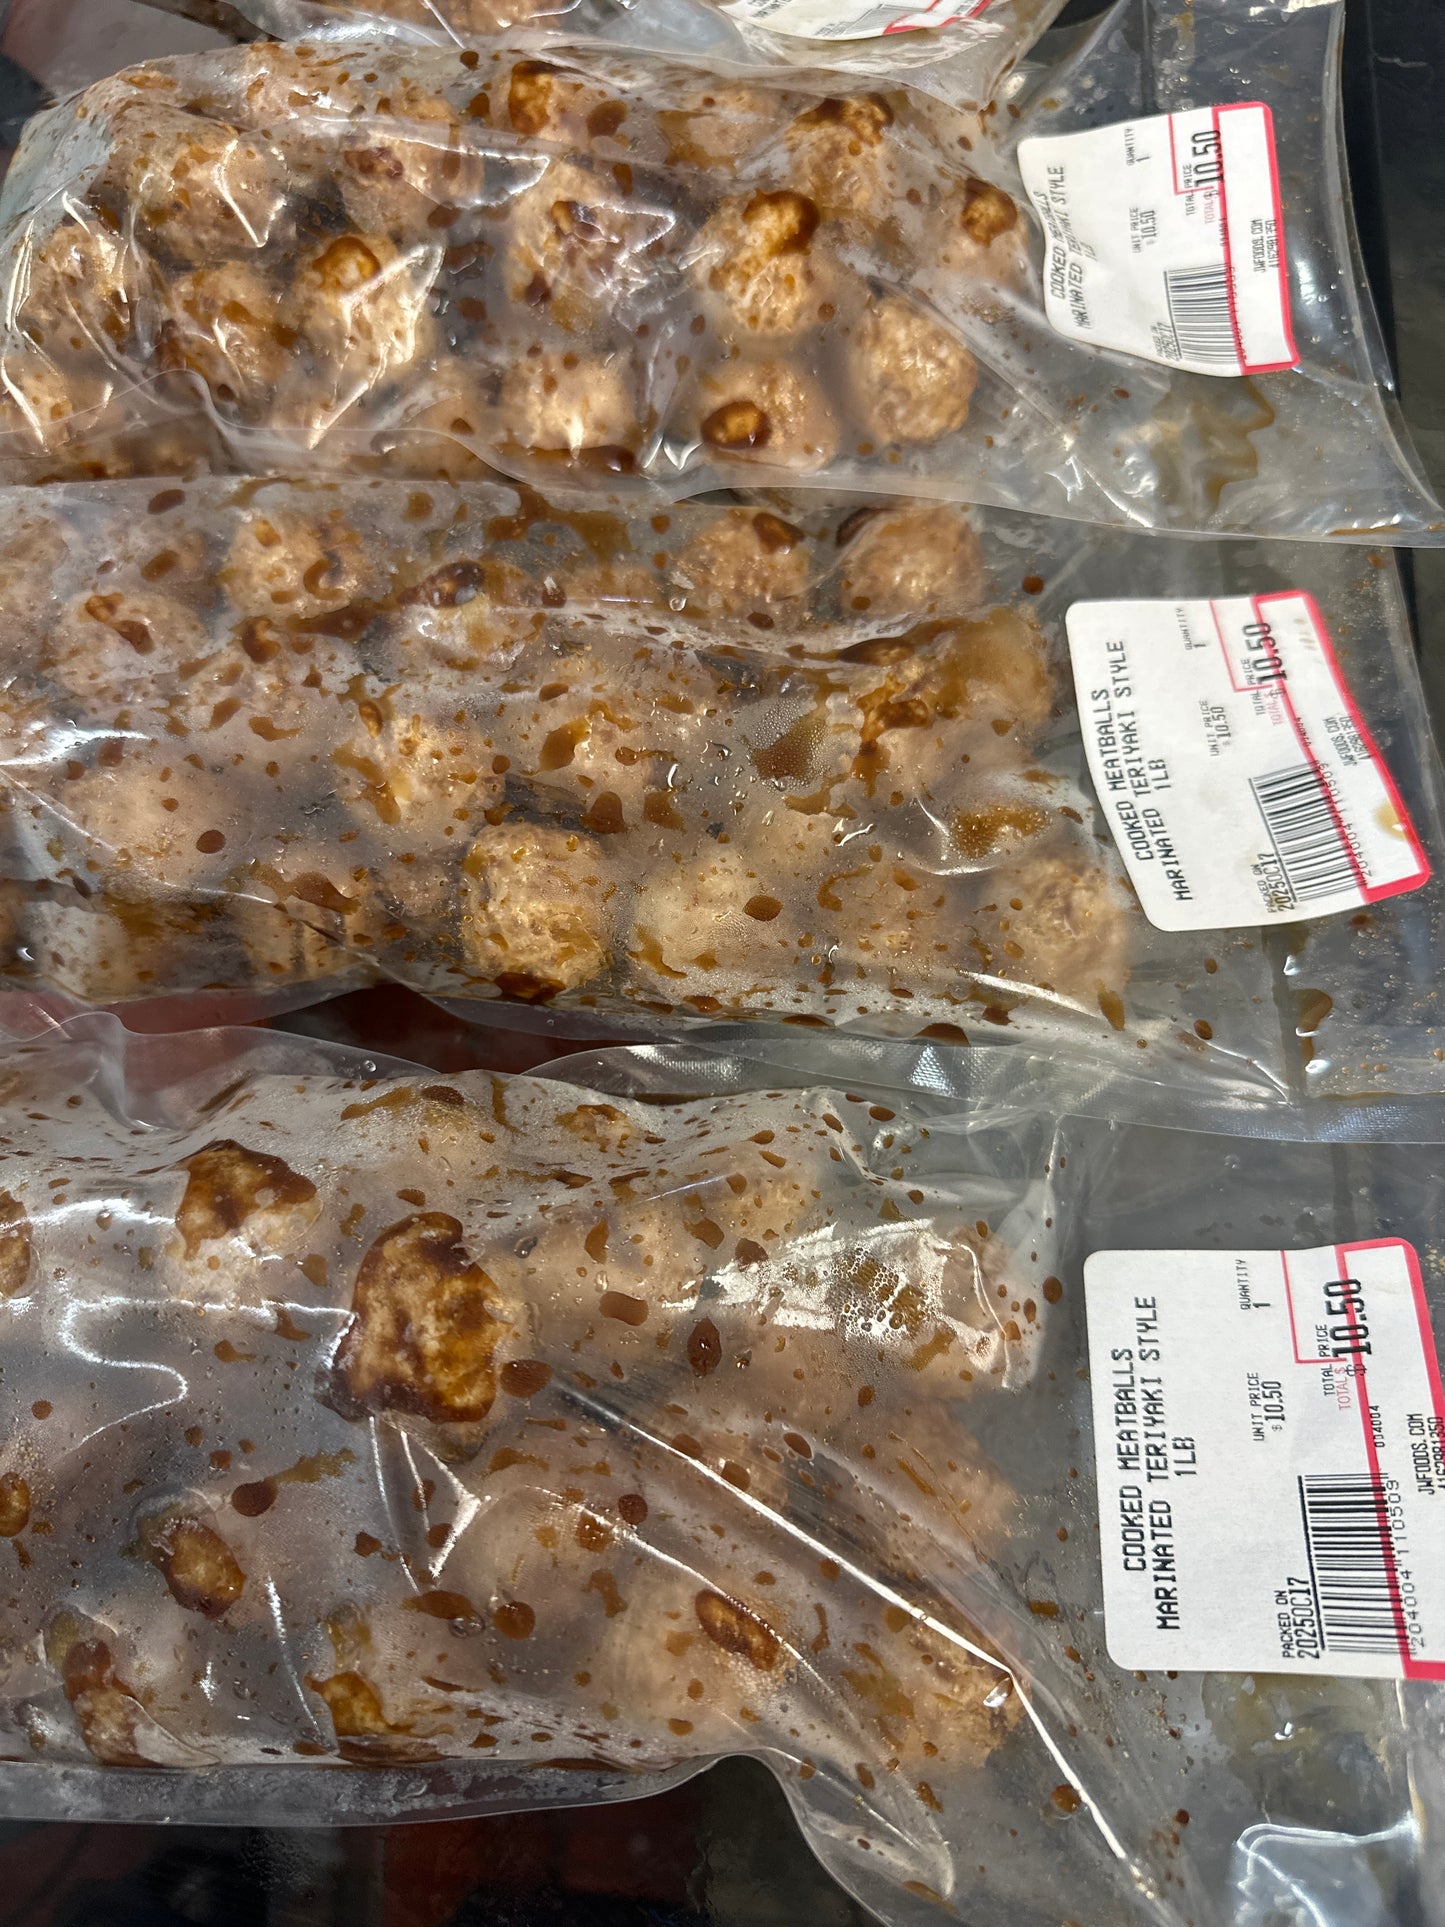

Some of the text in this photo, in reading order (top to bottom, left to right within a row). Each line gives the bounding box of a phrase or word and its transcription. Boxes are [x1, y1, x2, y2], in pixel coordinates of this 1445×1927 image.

[1124, 127, 1135, 166] QUANTITY
[1047, 166, 1066, 204] STYLE
[1182, 163, 1196, 216] TOTAL PRICE
[1129, 207, 1141, 253] UNIT PRICE
[1050, 245, 1066, 300] COOKED
[1068, 262, 1092, 329] MARINATED
[1175, 608, 1193, 650] QUANTITY
[1241, 658, 1265, 715] TOTAL PRICE
[1199, 700, 1219, 756] UNIT PRICE
[1091, 688, 1154, 861] COOKED MEATBALLS
[1106, 640, 1193, 901] MARINATED TERIYAKI STYLE
[1148, 758, 1171, 790] 1LB
[1250, 864, 1277, 913] PACKED ON
[1235, 1259, 1251, 1310] QUANTITY
[1315, 1324, 1334, 1397] TOTAL PRICE
[1247, 1372, 1264, 1441] UNIT PRICE
[1336, 1377, 1351, 1411] TOTAL
[1111, 1348, 1147, 1571] COOKED MEATBALLS
[1134, 1296, 1180, 1630] MARINATED TERIYAKI STYLE
[1172, 1436, 1197, 1476] 1LB
[1386, 1479, 1425, 1647] 204004 110509
[1274, 1590, 1295, 1658] PACKED ON
